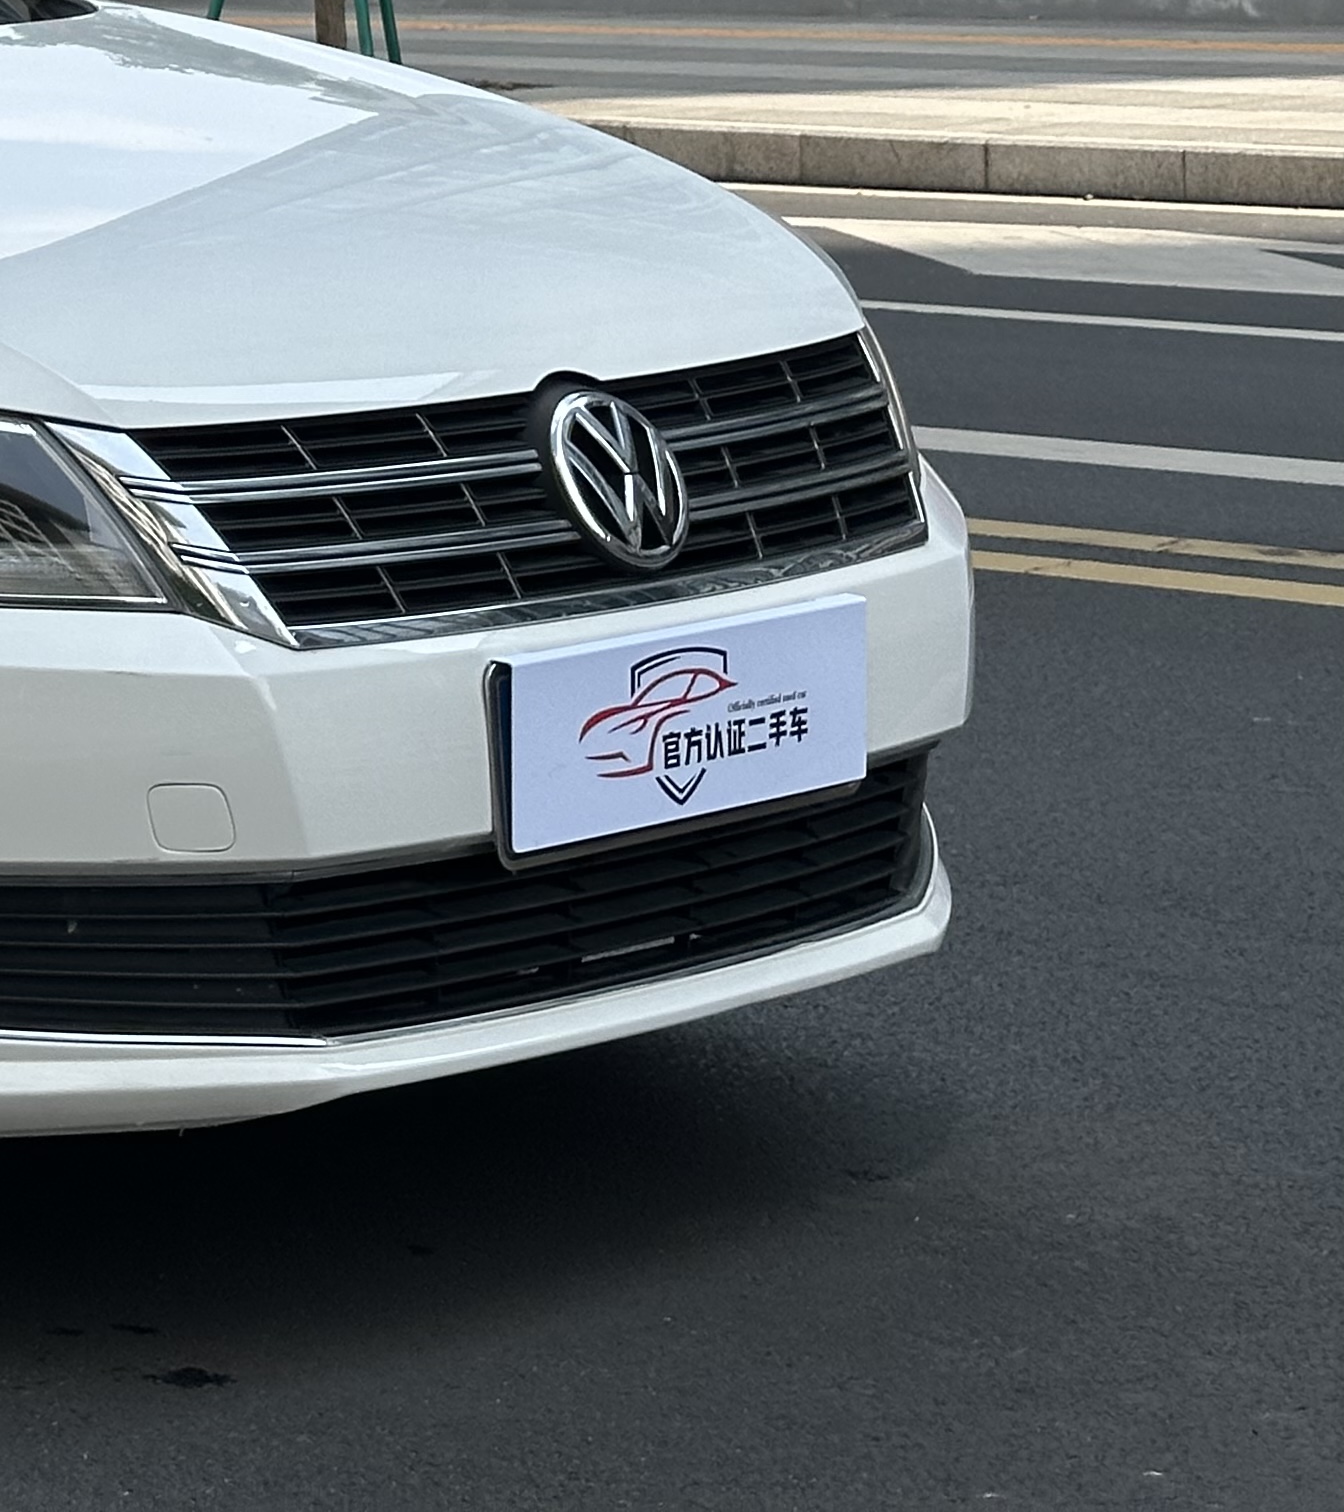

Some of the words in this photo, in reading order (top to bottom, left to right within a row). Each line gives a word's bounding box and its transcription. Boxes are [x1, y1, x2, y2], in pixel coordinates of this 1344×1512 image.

[662, 706, 809, 770] 官方认证二手车
